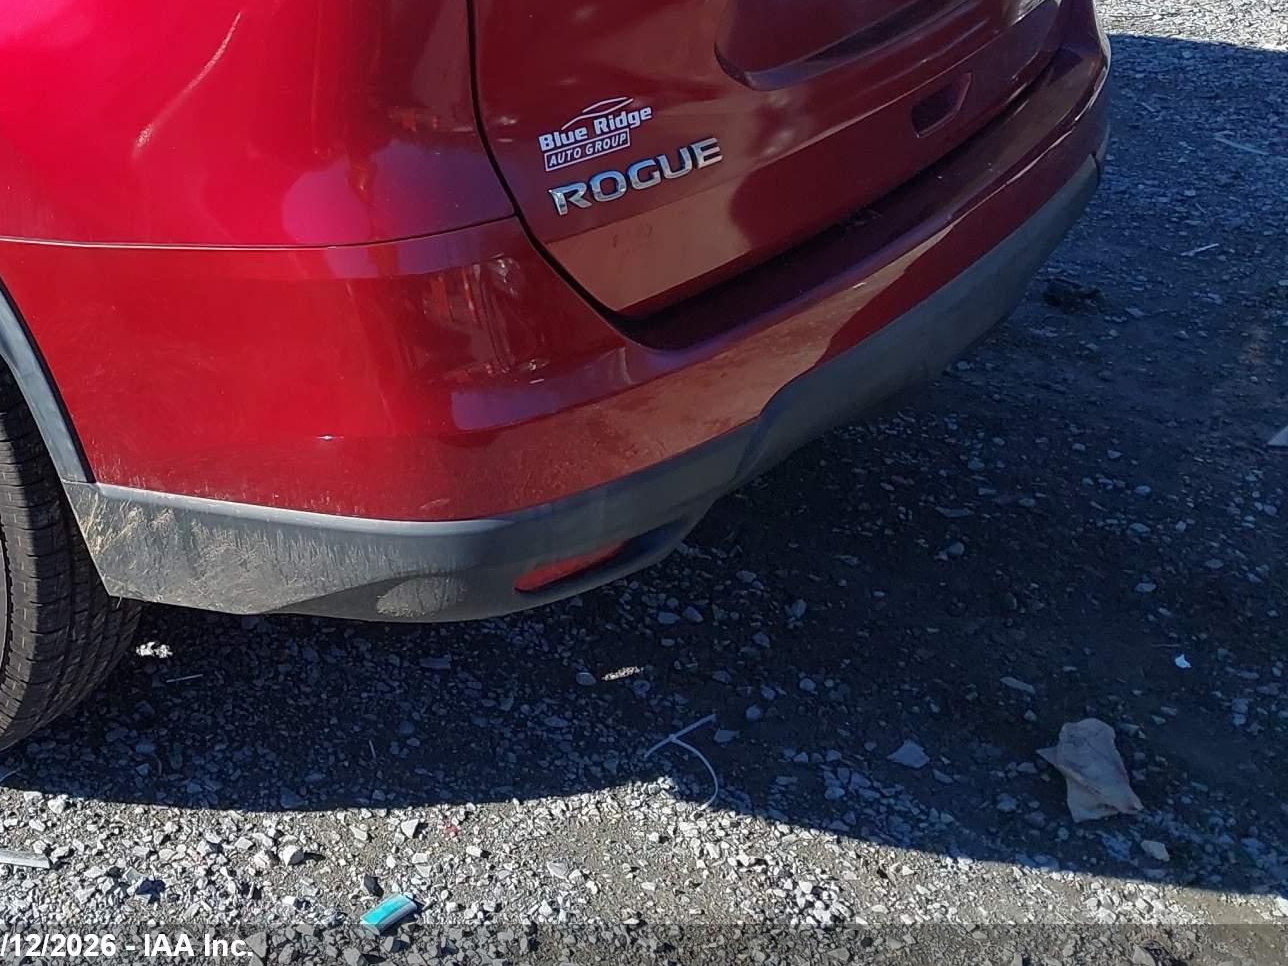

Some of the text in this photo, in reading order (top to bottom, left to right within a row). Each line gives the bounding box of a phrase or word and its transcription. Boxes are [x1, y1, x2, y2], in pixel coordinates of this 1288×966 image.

[538, 106, 653, 152] Blue Ridge
[549, 132, 628, 167] AUTO GROUP
[548, 137, 724, 216] ROGUE
